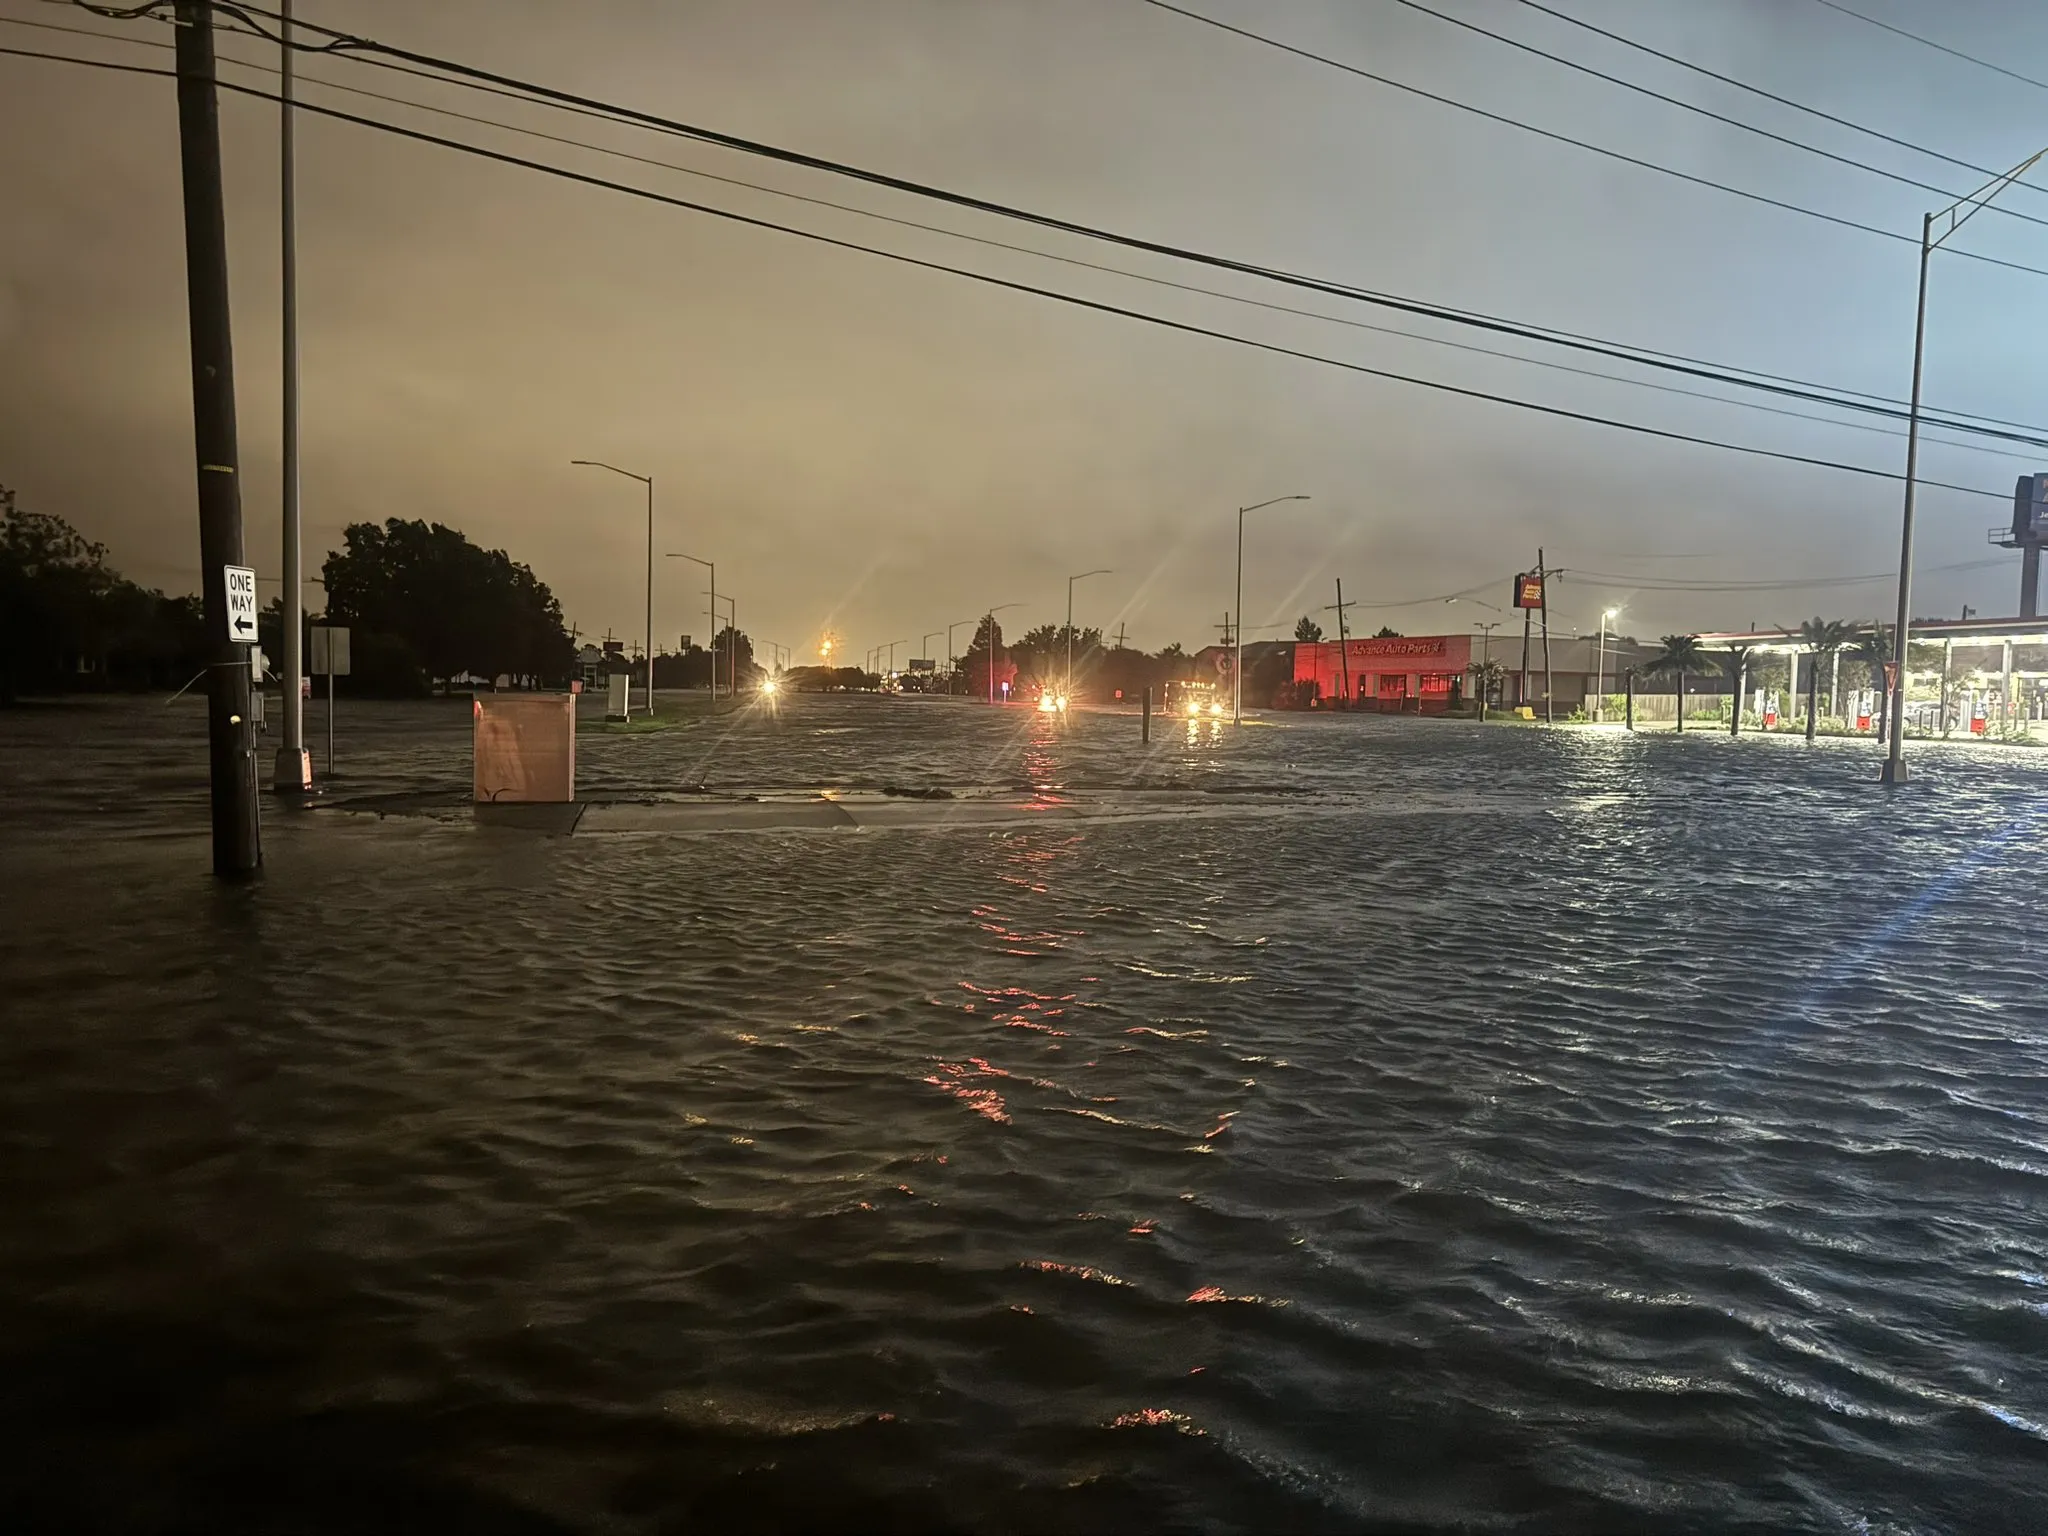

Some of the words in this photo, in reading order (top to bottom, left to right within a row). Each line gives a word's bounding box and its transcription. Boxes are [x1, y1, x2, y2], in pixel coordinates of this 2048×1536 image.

[230, 573, 252, 592] ONE
[230, 594, 253, 612] WAY
[1351, 645, 1384, 655] Advance
[1385, 643, 1405, 653] Auto
[1406, 642, 1431, 653] Parts
